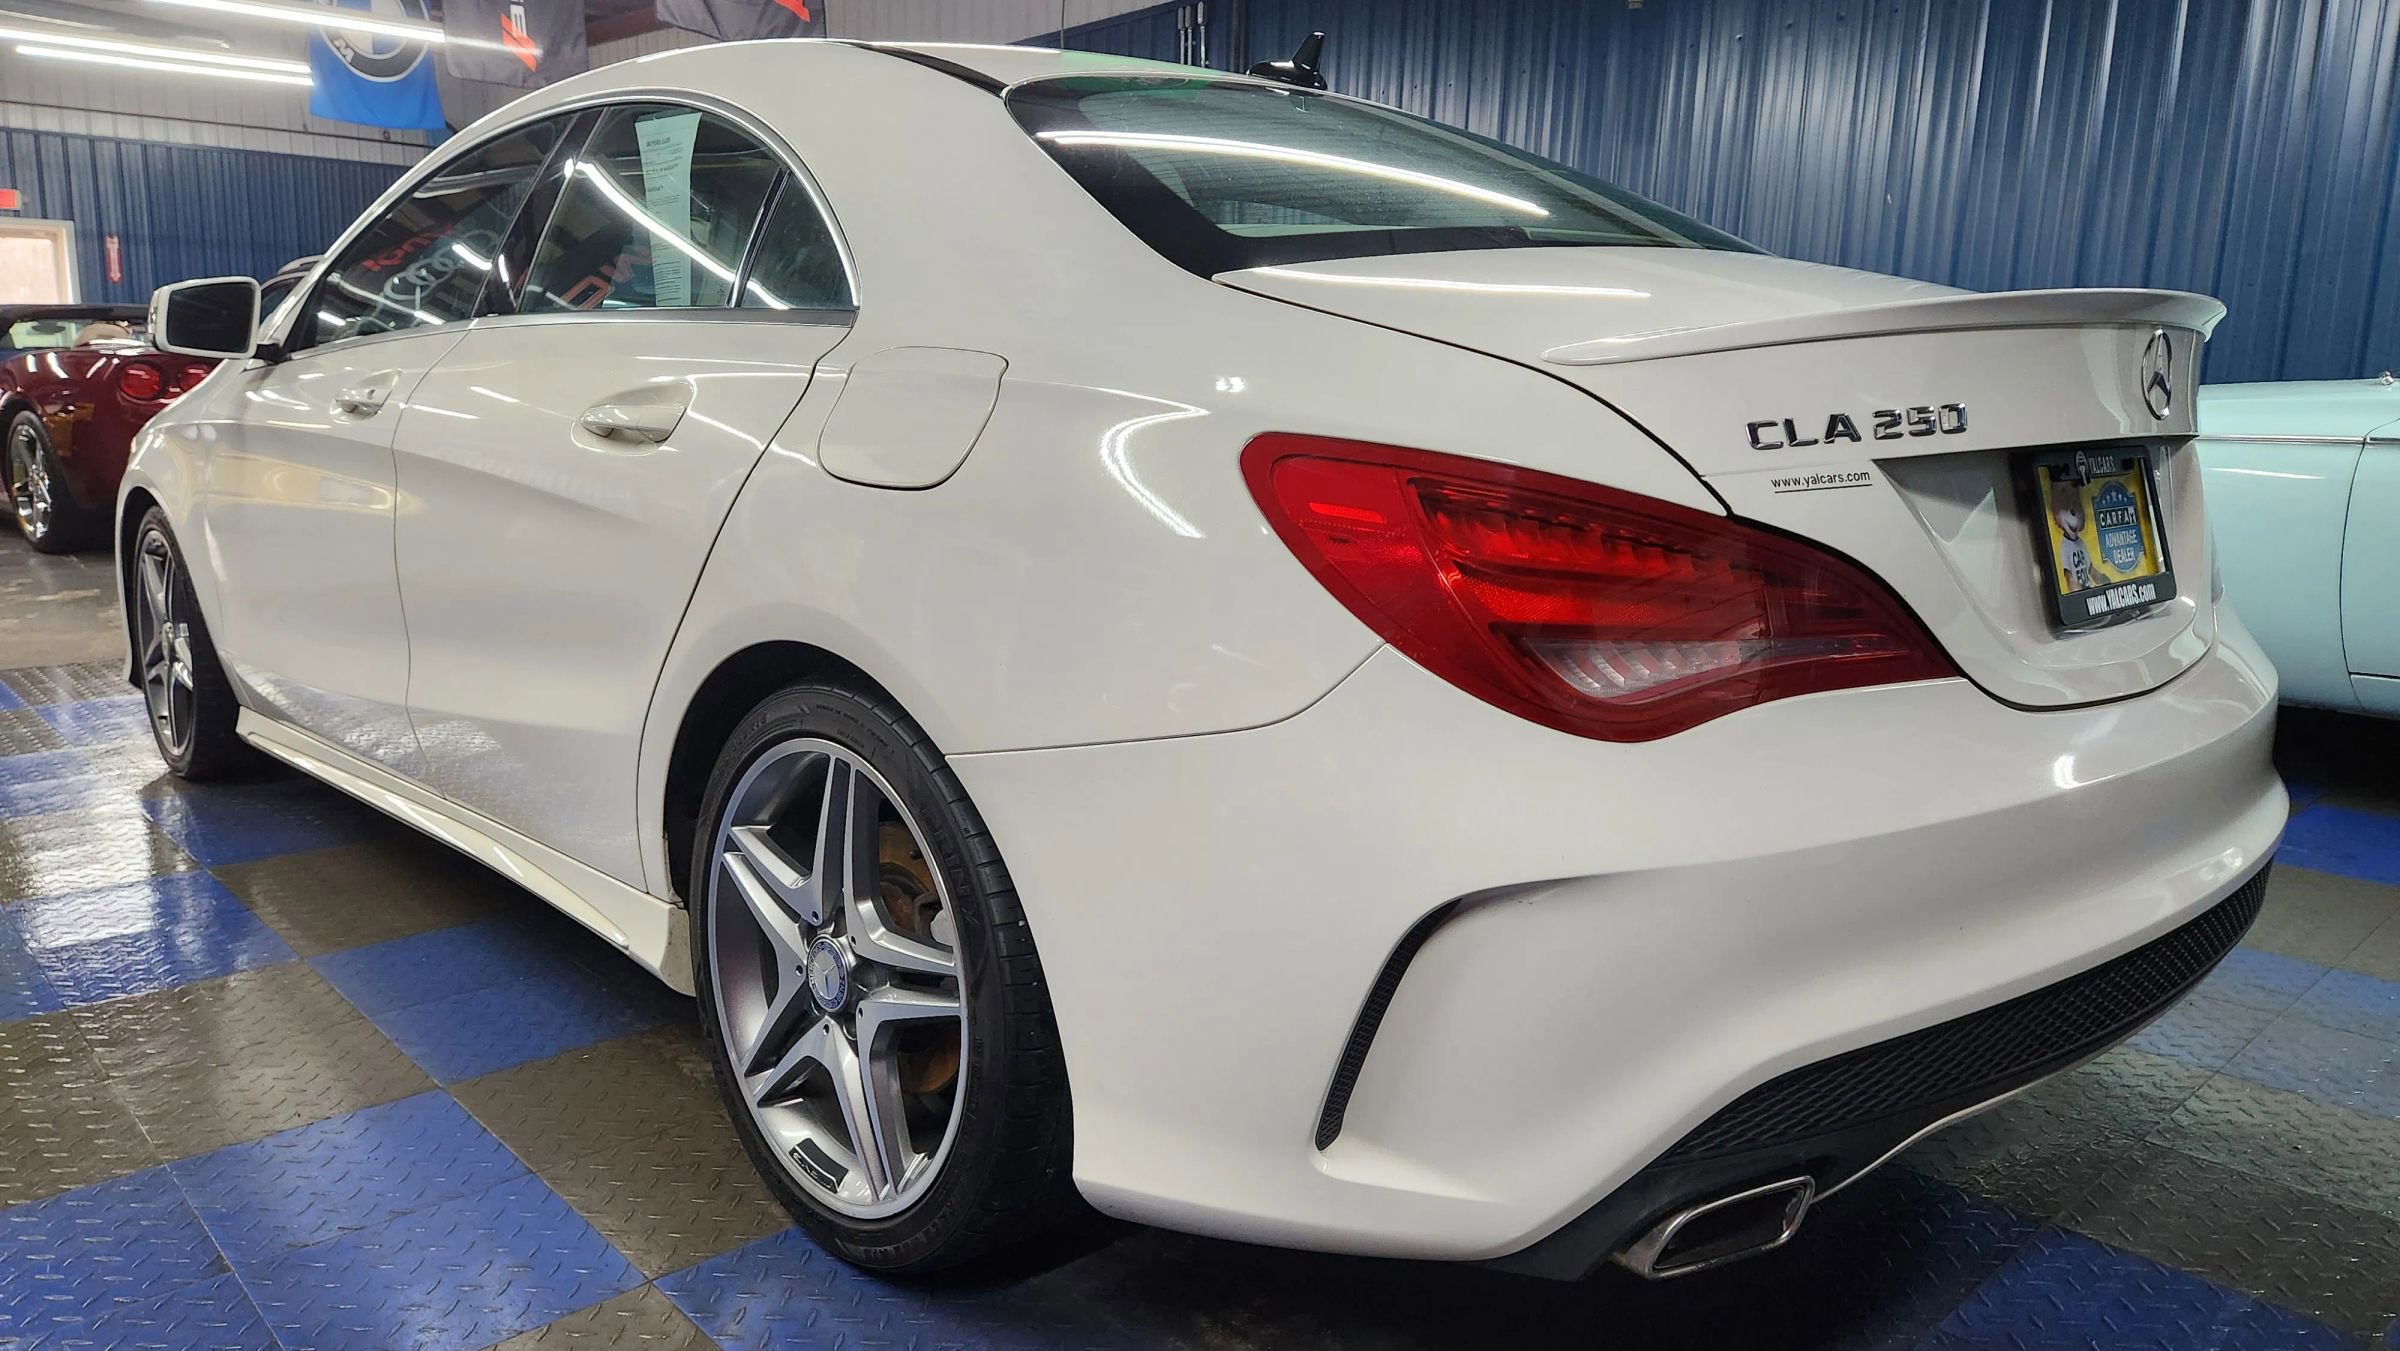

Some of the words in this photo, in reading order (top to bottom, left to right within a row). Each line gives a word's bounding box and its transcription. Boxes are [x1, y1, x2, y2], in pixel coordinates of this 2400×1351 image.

[1745, 412, 1862, 450] CLA
[1872, 402, 1968, 440] 250
[1771, 470, 1871, 488] www.yalcars.com
[2099, 505, 2137, 527] CARFAX
[2105, 529, 2138, 549] ADVANTAGE
[2113, 546, 2136, 565] DEALER
[2086, 583, 2157, 616] www.YALCARS.com
